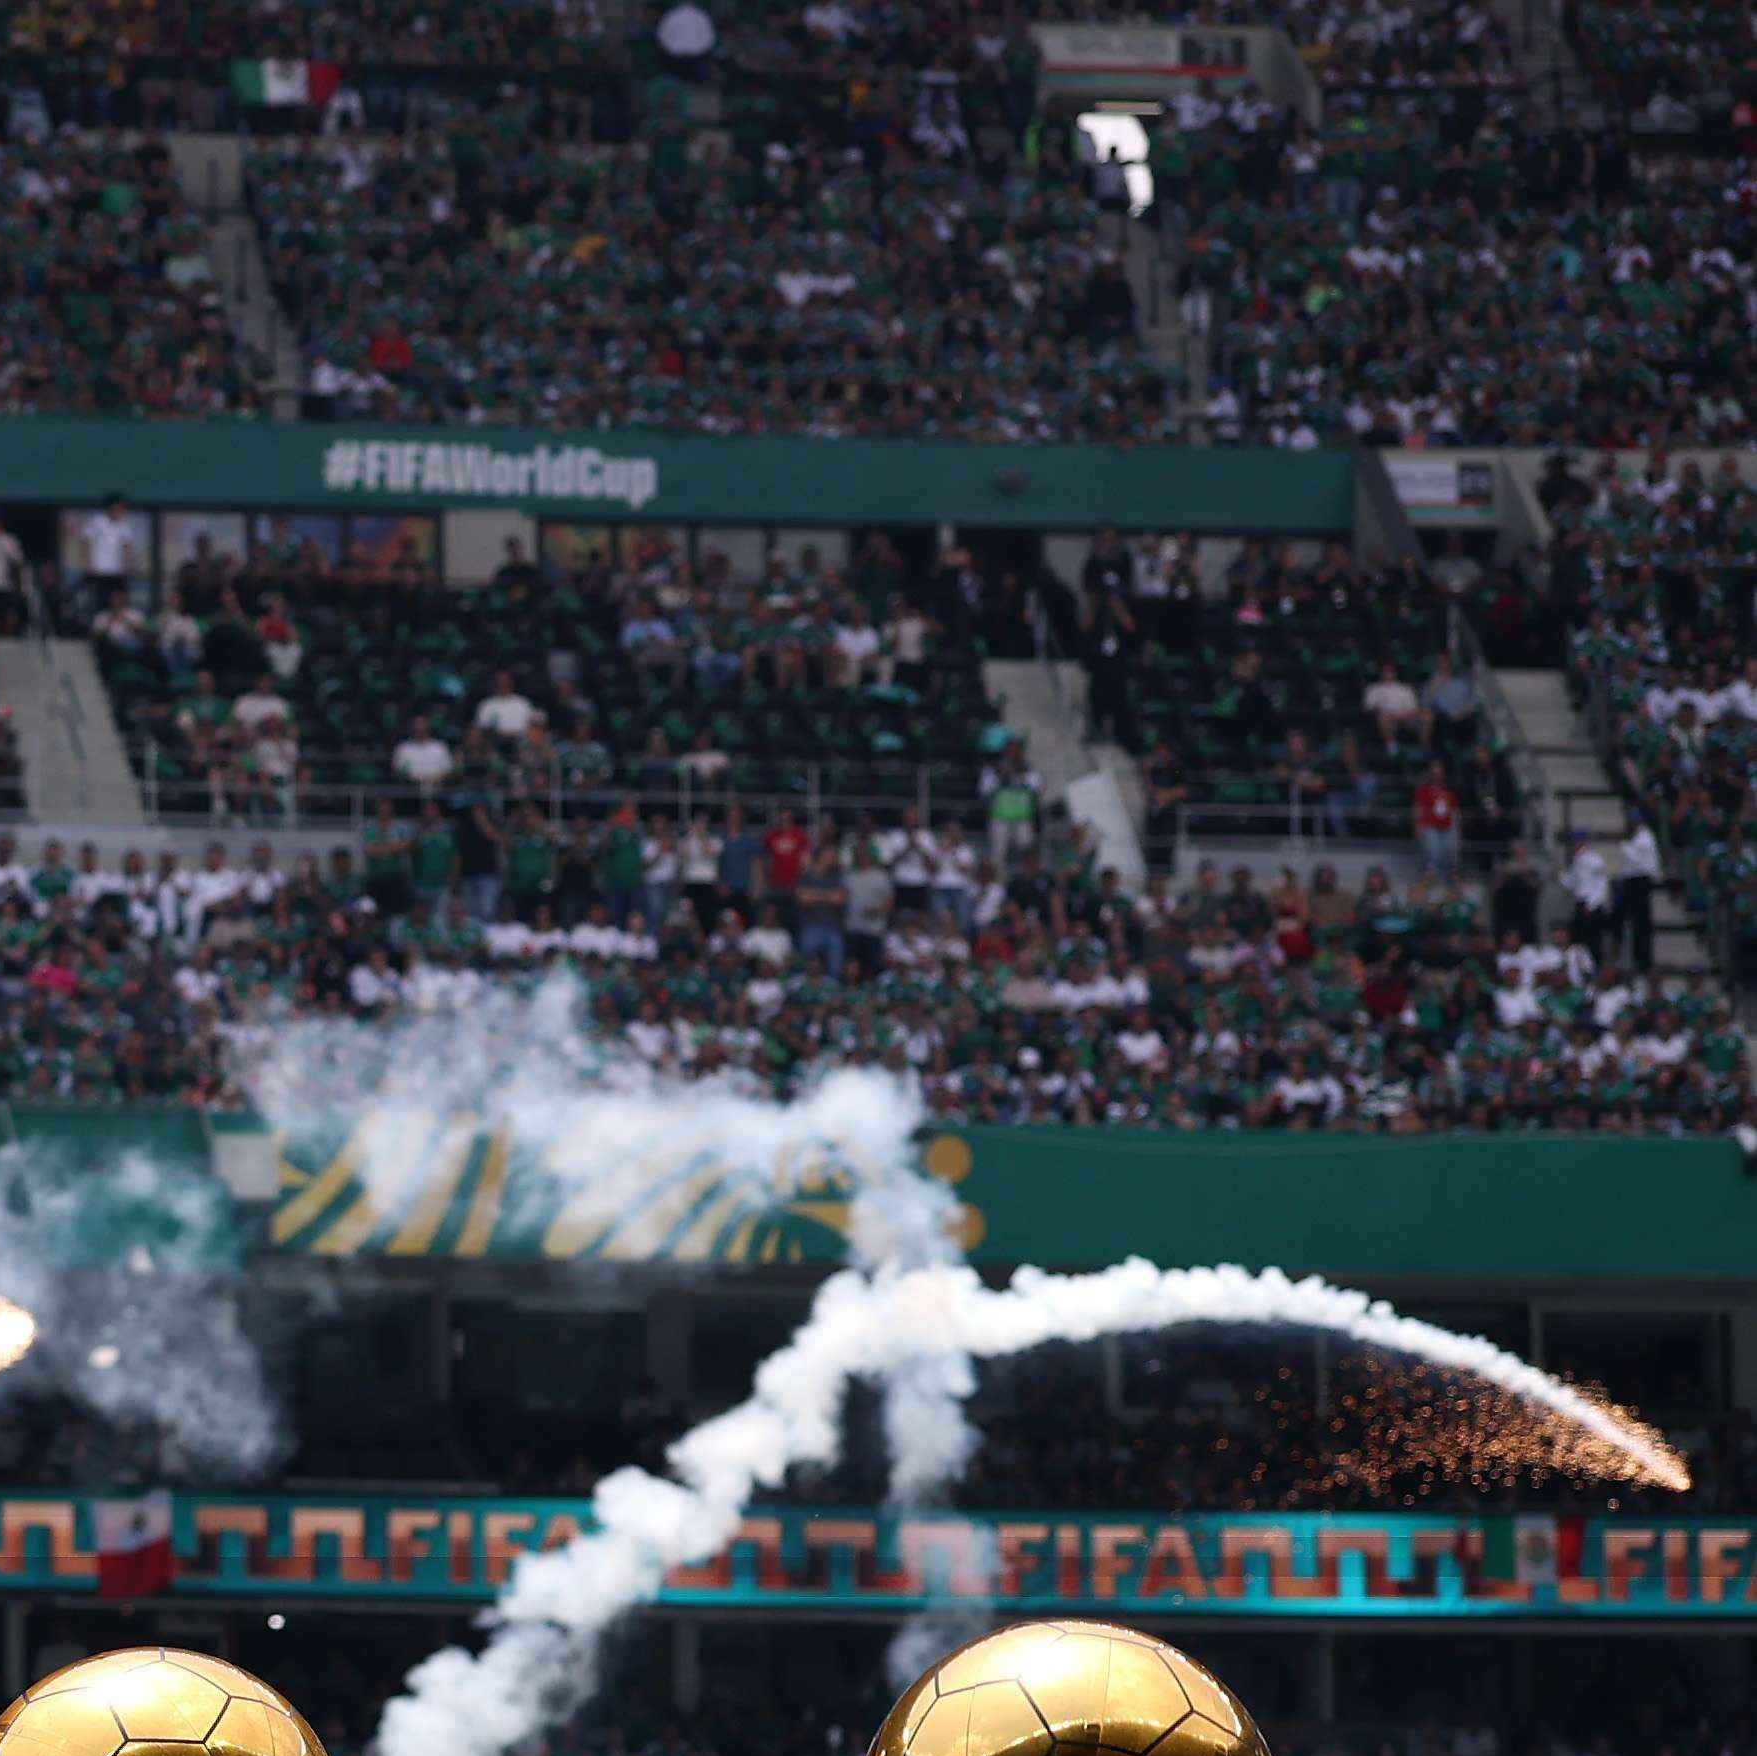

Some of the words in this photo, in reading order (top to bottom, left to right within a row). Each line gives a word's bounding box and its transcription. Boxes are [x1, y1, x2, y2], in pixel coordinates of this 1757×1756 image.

[323, 439, 658, 510] #FIFAWorldCup
[1000, 1525, 1207, 1597] FIFA
[1605, 1529, 1757, 1603] FIF
